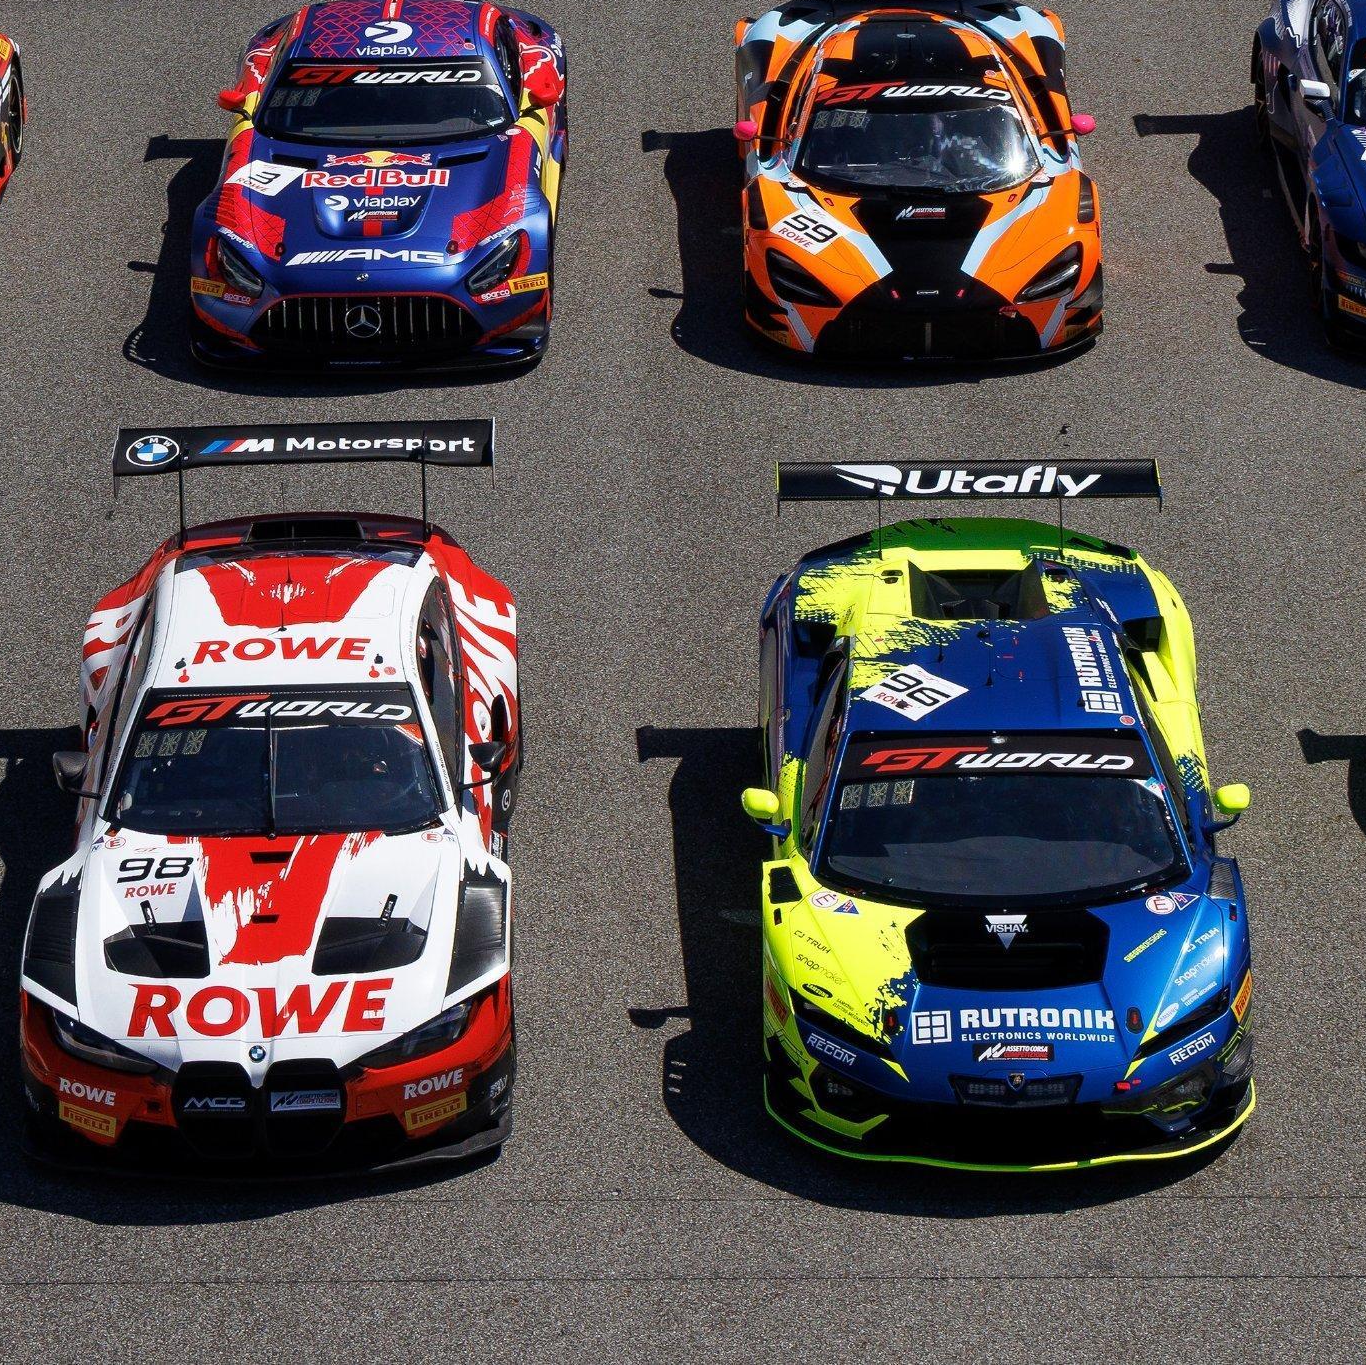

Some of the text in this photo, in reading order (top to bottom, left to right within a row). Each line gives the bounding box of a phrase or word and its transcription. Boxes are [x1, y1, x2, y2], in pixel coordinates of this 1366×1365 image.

[356, 44, 417, 58] viaplay
[304, 170, 447, 187] Red Bull
[352, 196, 421, 209] viaplay
[777, 227, 813, 249] ROWE
[782, 214, 838, 243] 59
[338, 248, 444, 263] AMG
[481, 289, 510, 299] sparco
[513, 276, 546, 290] PIRELLI
[224, 293, 251, 302] sparco
[134, 436, 173, 450] BMW
[286, 435, 475, 458] Motorsport
[905, 465, 1101, 497] Utafly
[192, 637, 372, 666] ROWE
[116, 857, 195, 883] 98
[124, 882, 176, 898] ROWE
[985, 923, 1027, 934] VISHAY
[796, 954, 847, 985] snapmaker
[127, 977, 394, 1038] ROWE
[961, 1008, 1115, 1031] RUTRONIK
[961, 1032, 1116, 1043] ELECTRONICS WORLDWIDE
[1169, 1032, 1216, 1065] RECOM
[807, 1033, 856, 1066] RECOM
[58, 1078, 117, 1106] ROWE
[403, 1069, 465, 1100] ROWE
[62, 1105, 116, 1135] PIRELLI
[411, 1096, 463, 1127] PIRELLI
